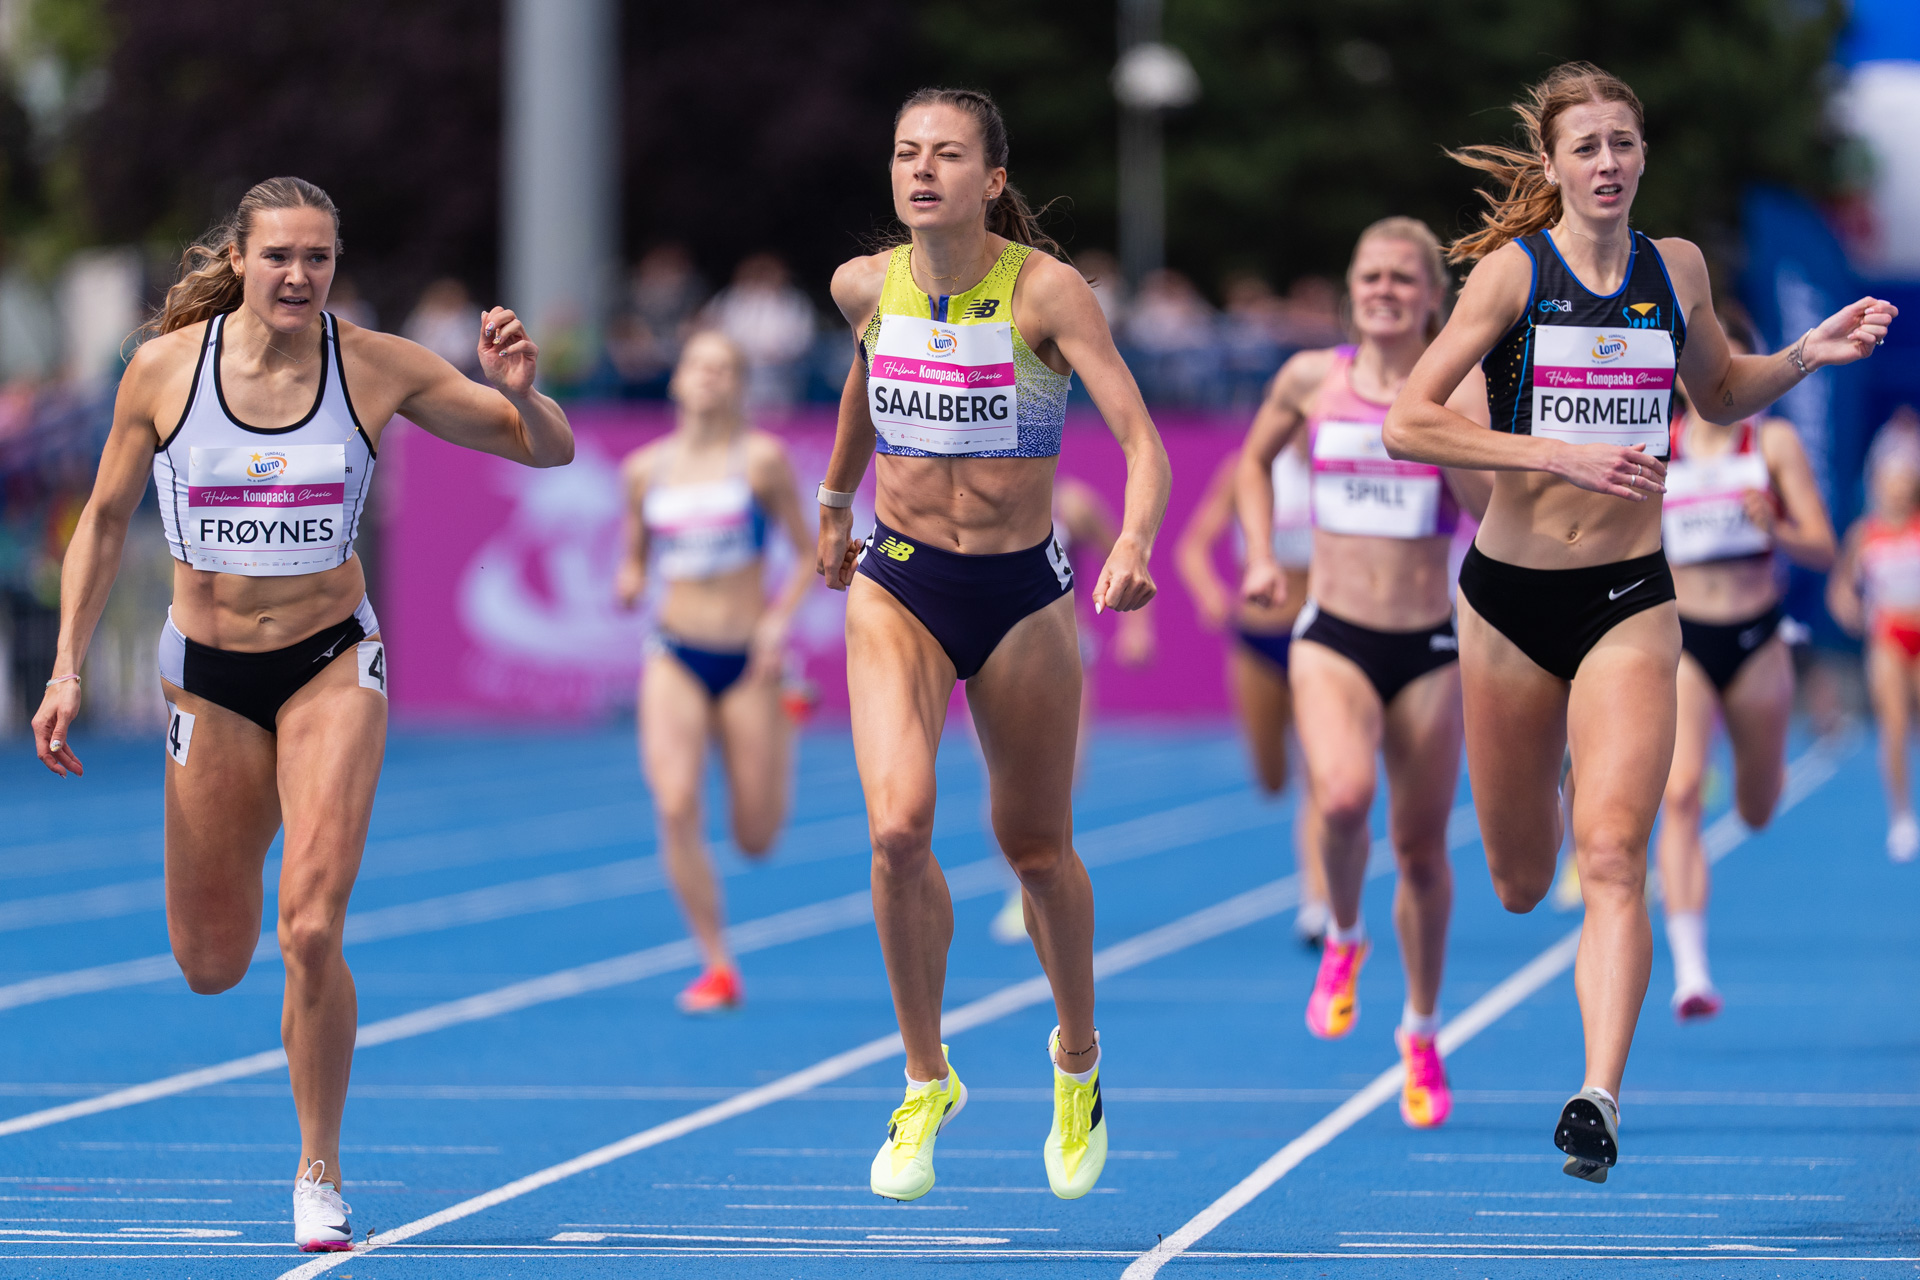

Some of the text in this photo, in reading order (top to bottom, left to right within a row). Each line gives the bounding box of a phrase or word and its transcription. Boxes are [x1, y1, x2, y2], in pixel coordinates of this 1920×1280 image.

[934, 337, 952, 349] LOTTO
[1599, 343, 1621, 355] LOTTO
[883, 361, 1002, 383] Halina Konopacka Classic
[1545, 371, 1664, 387] Halina Konopacka Classic
[875, 386, 1008, 422] SAALBERG
[1540, 395, 1661, 425] FORMELLA
[255, 460, 279, 473] LOTTO
[200, 488, 332, 505] Halina Konopacka Classic
[1345, 480, 1404, 508] SPILL
[200, 518, 334, 545] FRØYNES
[368, 646, 385, 690] 4
[169, 713, 181, 757] 4
